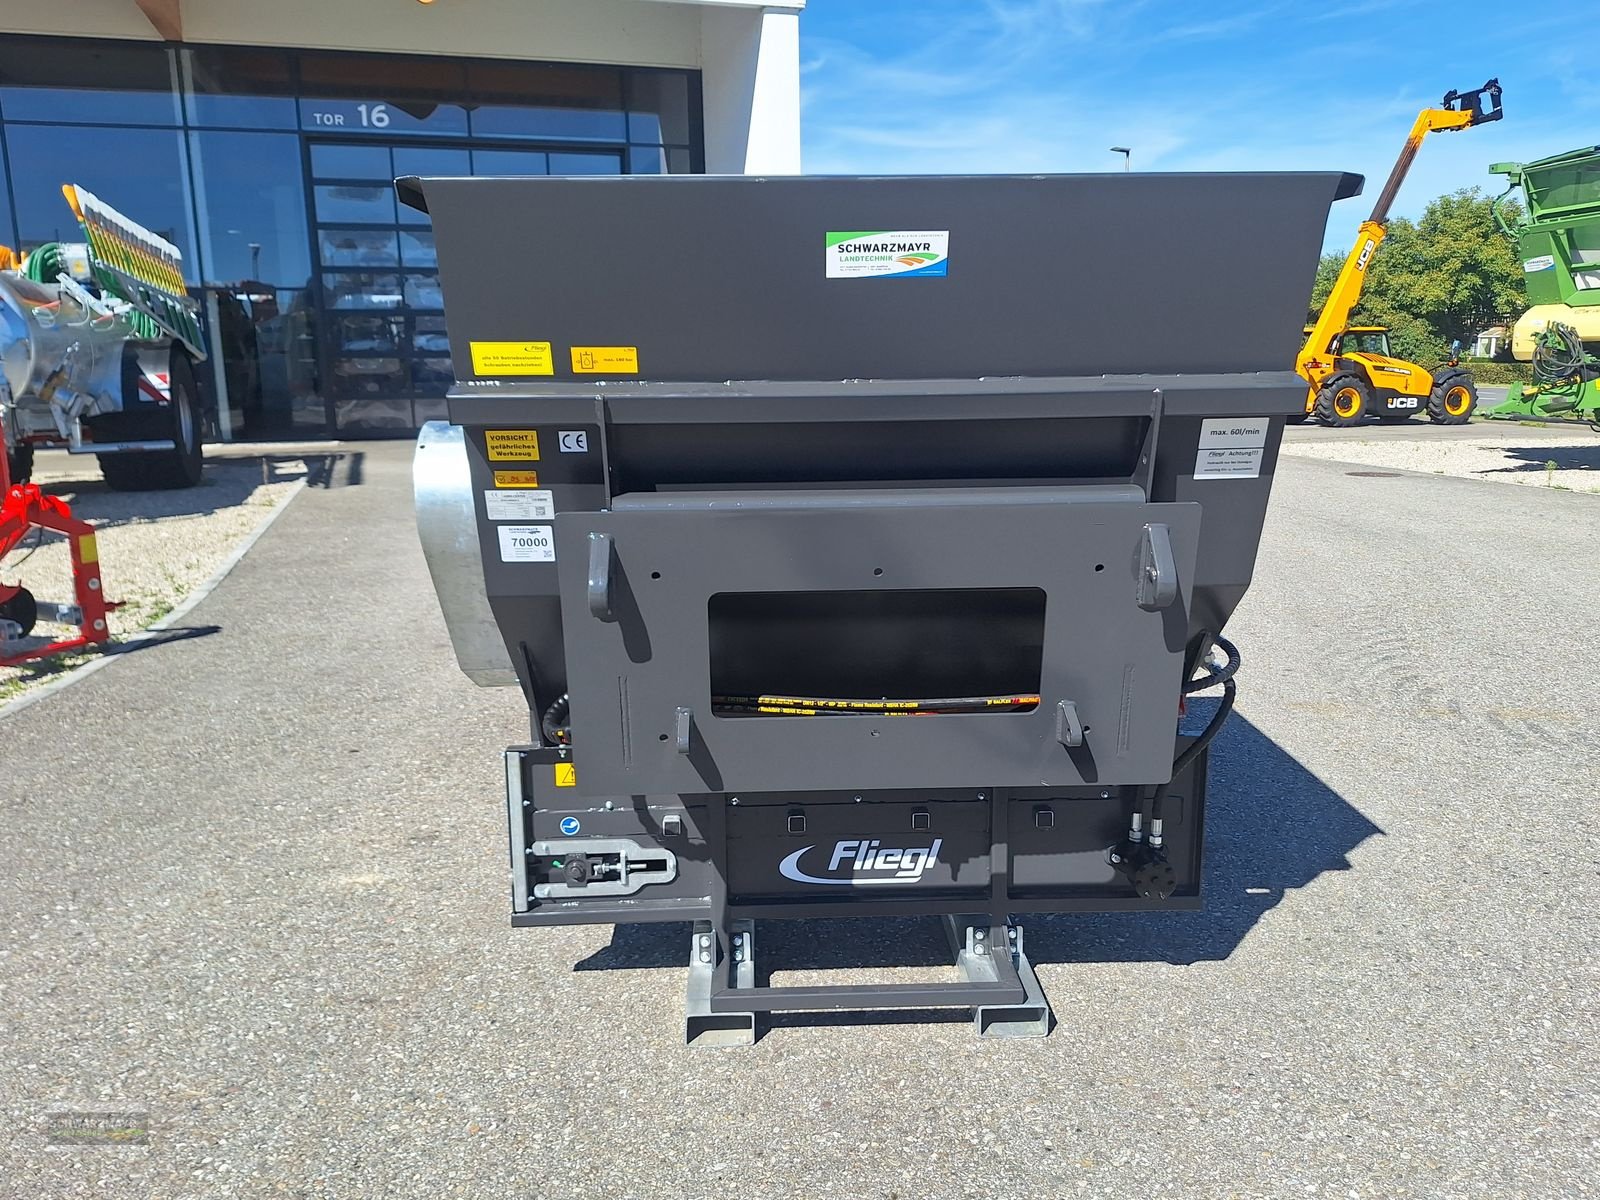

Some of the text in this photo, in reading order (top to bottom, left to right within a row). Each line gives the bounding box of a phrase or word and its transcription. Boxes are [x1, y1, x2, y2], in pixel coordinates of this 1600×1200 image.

[313, 103, 390, 128] TOR 16
[837, 242, 931, 254] SCHWARZMAYR
[839, 255, 893, 263] LANDTECHNIK
[1355, 239, 1375, 271] JCB
[1387, 398, 1418, 409] JCB
[1230, 427, 1260, 437] 60l/min
[490, 434, 529, 442] VORSICHT
[562, 433, 585, 449] CE
[490, 442, 536, 450] gefährliches
[511, 537, 548, 547] 70000
[827, 838, 943, 877] Fliegl
